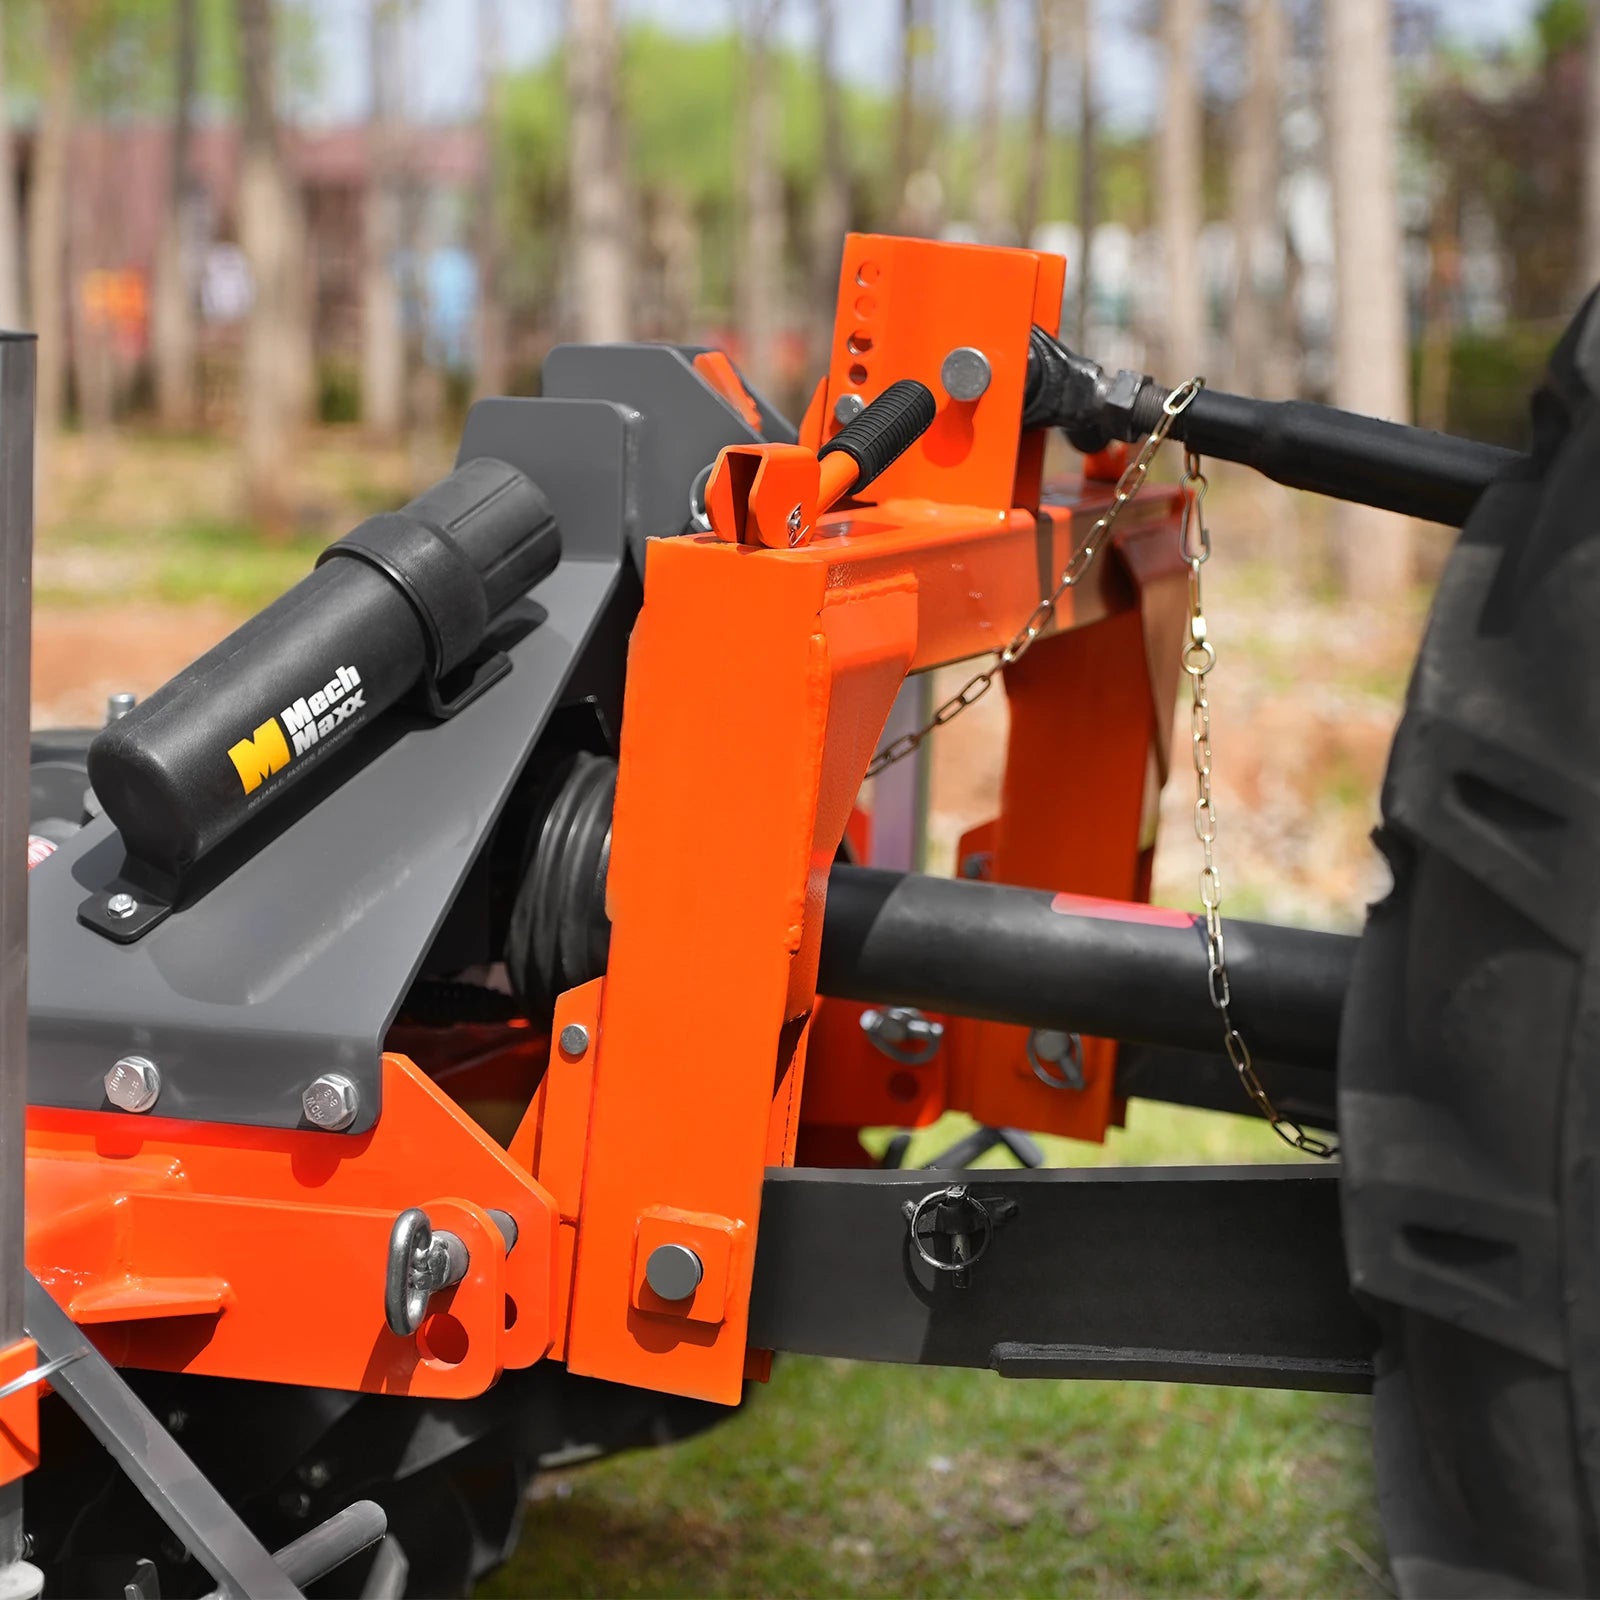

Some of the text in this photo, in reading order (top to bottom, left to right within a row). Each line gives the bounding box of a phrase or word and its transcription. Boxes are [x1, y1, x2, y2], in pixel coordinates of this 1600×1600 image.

[280, 665, 362, 736] Mech
[291, 687, 367, 758] Maxx
[226, 716, 291, 796] M
